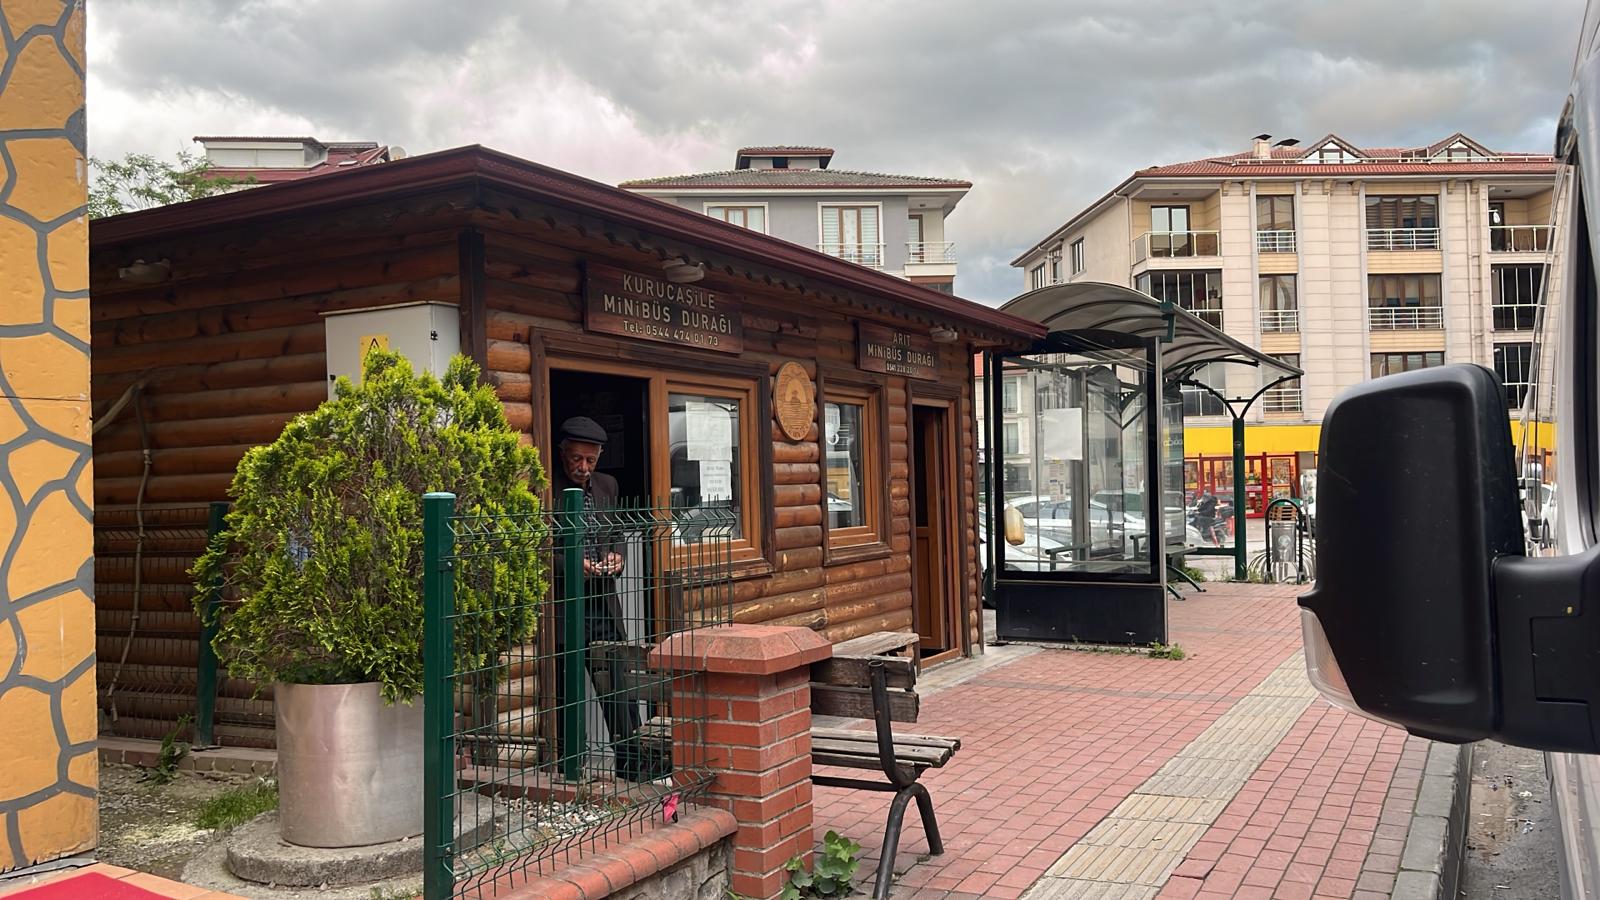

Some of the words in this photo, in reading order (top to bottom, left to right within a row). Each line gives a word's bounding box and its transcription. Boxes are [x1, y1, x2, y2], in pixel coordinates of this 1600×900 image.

[682, 310, 732, 335] DURAĞI
[623, 320, 643, 334] Tel:
[646, 326, 670, 338] 0544
[673, 330, 690, 342] 474
[694, 334, 704, 344] 01
[708, 335, 719, 346] 73
[893, 333, 910, 346] ARIT
[907, 352, 934, 367] DURAĞI
